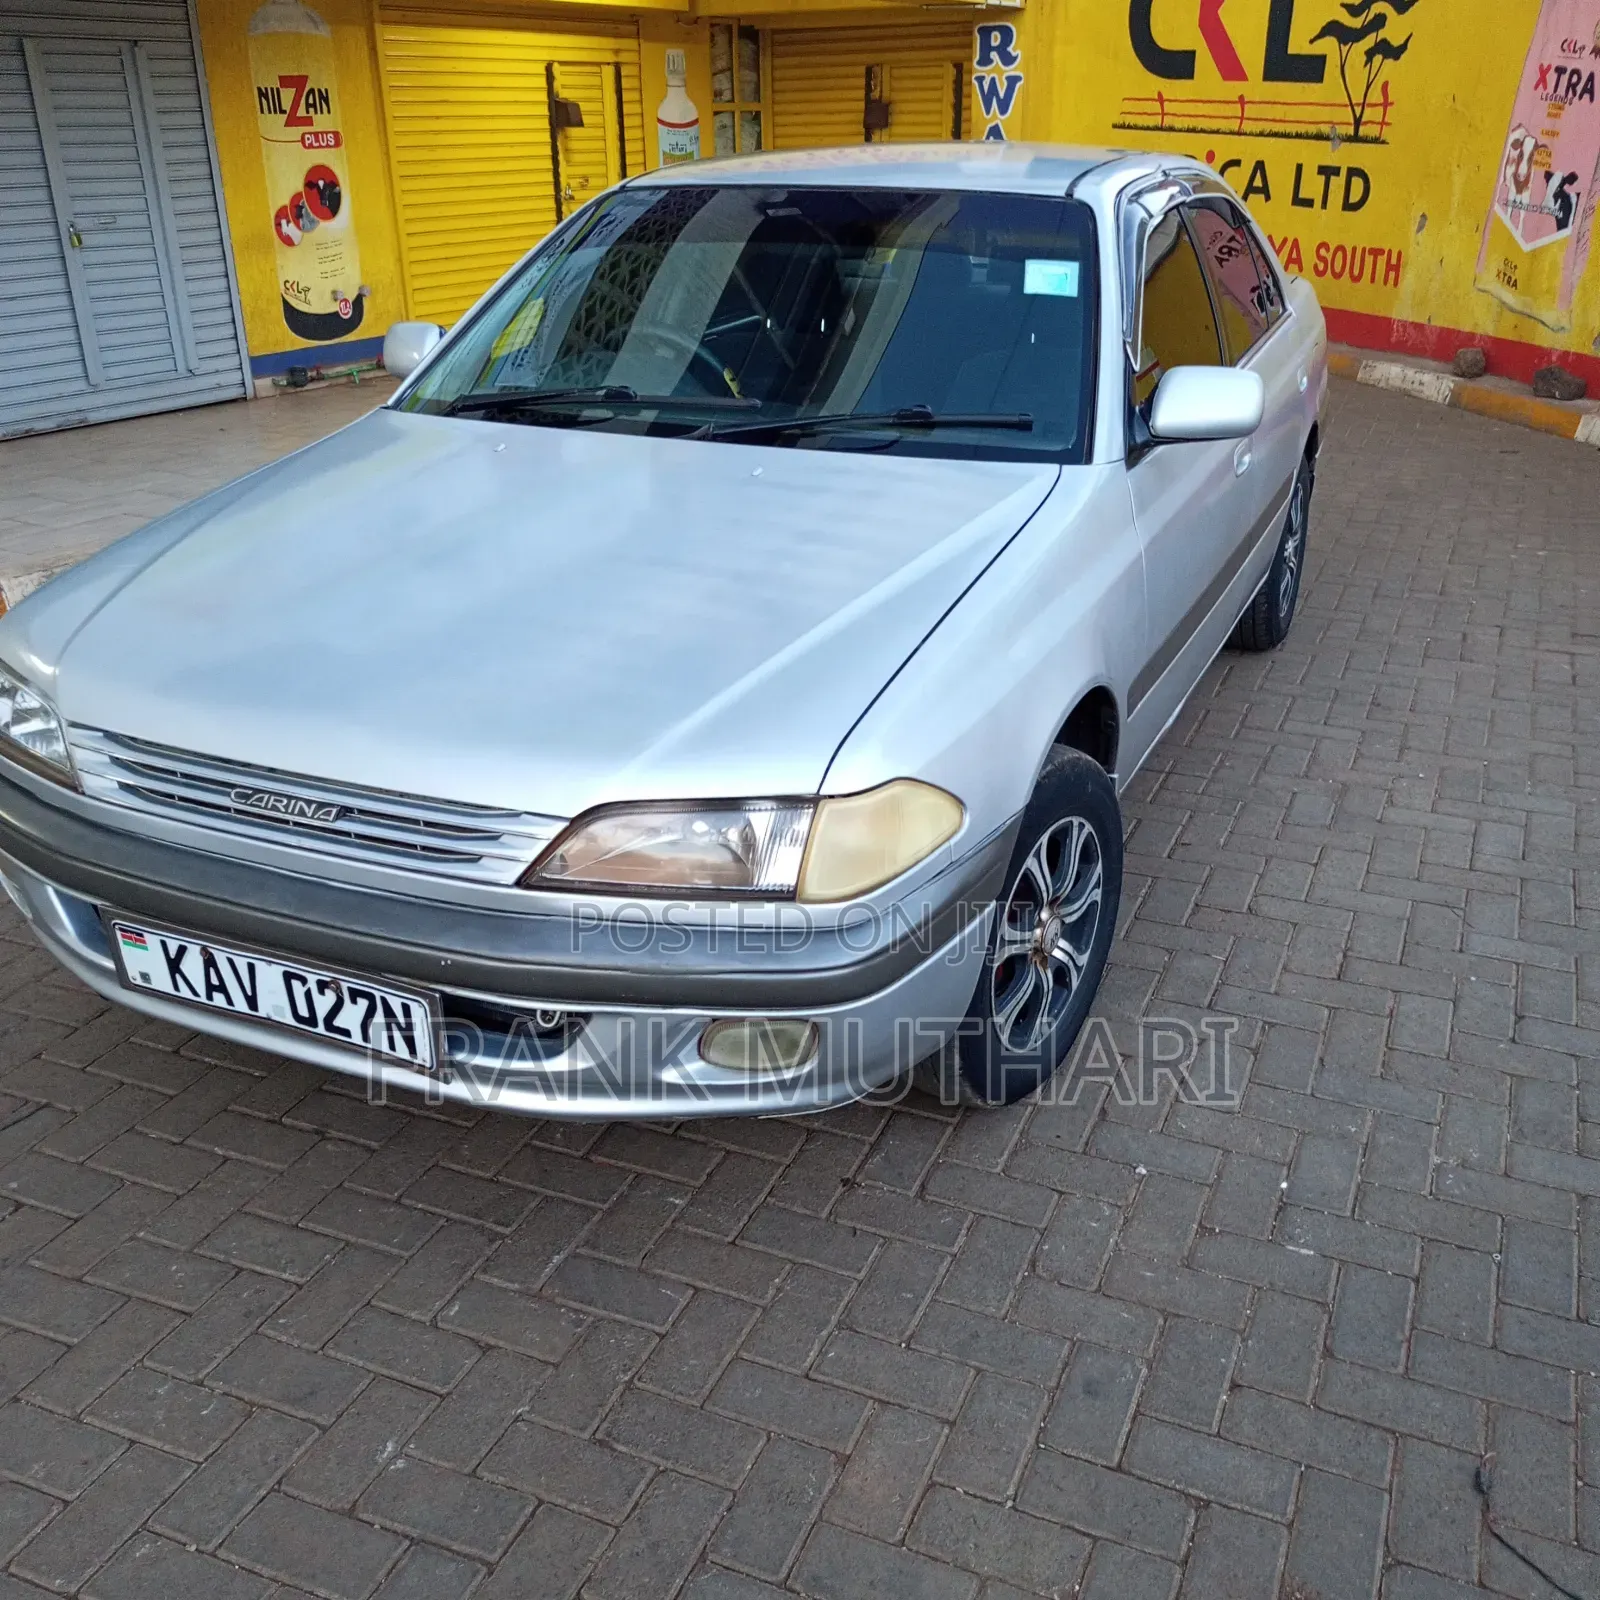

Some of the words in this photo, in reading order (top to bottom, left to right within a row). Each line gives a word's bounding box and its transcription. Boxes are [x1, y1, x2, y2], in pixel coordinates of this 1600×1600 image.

[1129, 0, 1327, 83] CKL
[257, 75, 331, 127] NILZAN
[1534, 63, 1595, 104] XTRA
[304, 133, 336, 147] PLUS
[1291, 162, 1371, 213] LTD
[1267, 234, 1304, 273] YA
[1313, 241, 1403, 288] SOUTH
[1496, 268, 1518, 290] XTRA
[230, 787, 341, 822] CARINA
[160, 938, 259, 1012] KAV
[282, 969, 418, 1059] 027N
